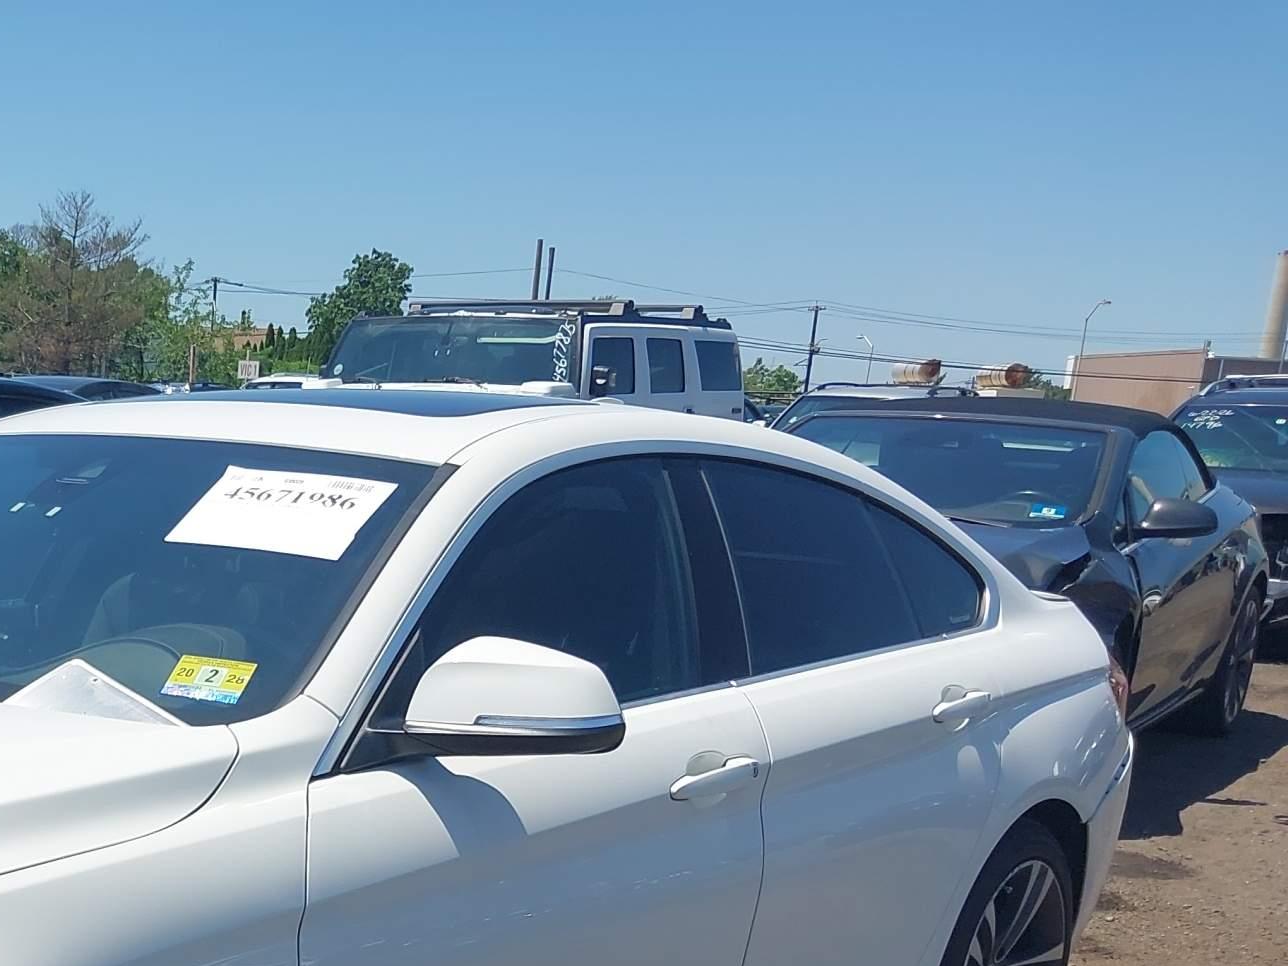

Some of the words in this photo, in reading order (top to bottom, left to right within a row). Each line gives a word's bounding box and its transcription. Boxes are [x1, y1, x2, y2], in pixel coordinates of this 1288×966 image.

[224, 486, 360, 510] 45671986
[176, 667, 195, 678] 20
[204, 669, 219, 683] 2
